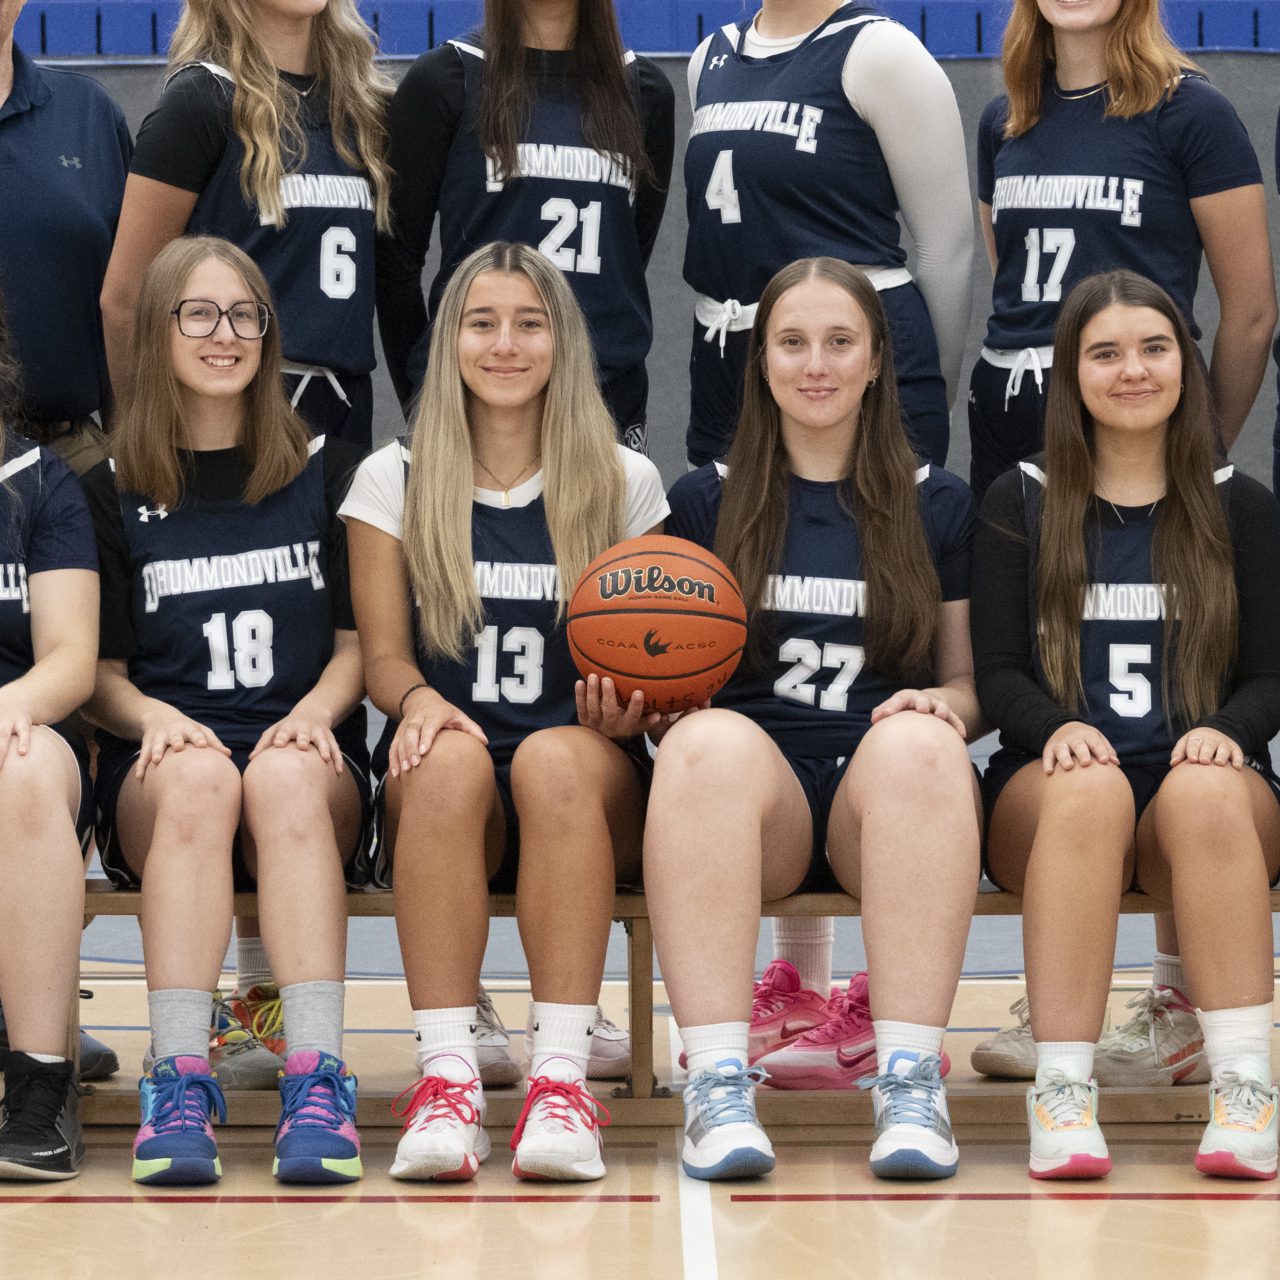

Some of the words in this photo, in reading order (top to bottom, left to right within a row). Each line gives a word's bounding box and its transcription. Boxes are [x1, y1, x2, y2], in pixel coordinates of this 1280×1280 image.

[705, 149, 742, 224] 4
[320, 226, 357, 300] 6
[539, 197, 603, 275] 21
[1021, 228, 1077, 303] 17
[142, 540, 325, 614] DRUMMONDVILLE
[599, 564, 716, 605] Wilson
[202, 608, 274, 691] 18
[471, 625, 546, 703] 13
[596, 638, 639, 650] CCAA
[674, 641, 717, 651] ACSC
[773, 636, 866, 712] 27
[1108, 643, 1152, 718] 5
